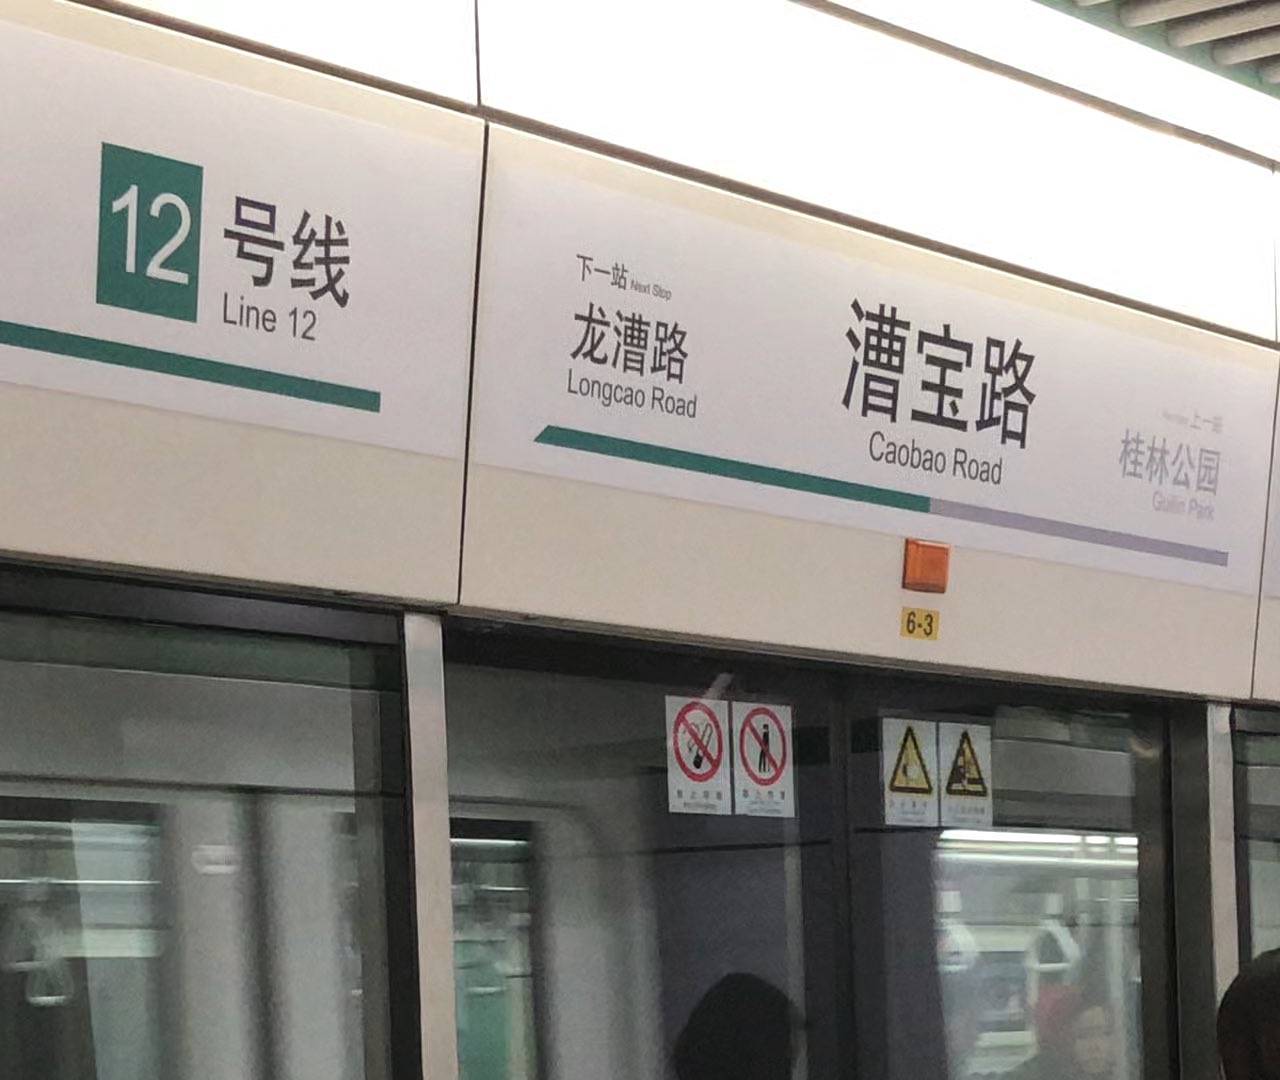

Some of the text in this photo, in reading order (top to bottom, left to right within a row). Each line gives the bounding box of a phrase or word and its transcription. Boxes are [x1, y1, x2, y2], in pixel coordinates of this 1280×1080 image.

[111, 184, 350, 308] 12 号线
[576, 254, 628, 290] 下一站
[223, 291, 317, 341] Line 12
[570, 301, 689, 384] 龙漕路
[567, 368, 698, 418] Longcao Road
[841, 297, 1037, 449] 漕宝路
[869, 430, 1003, 485] Caobao Road
[1118, 428, 1222, 496] 桂林公园
[906, 610, 934, 637] 6-3
